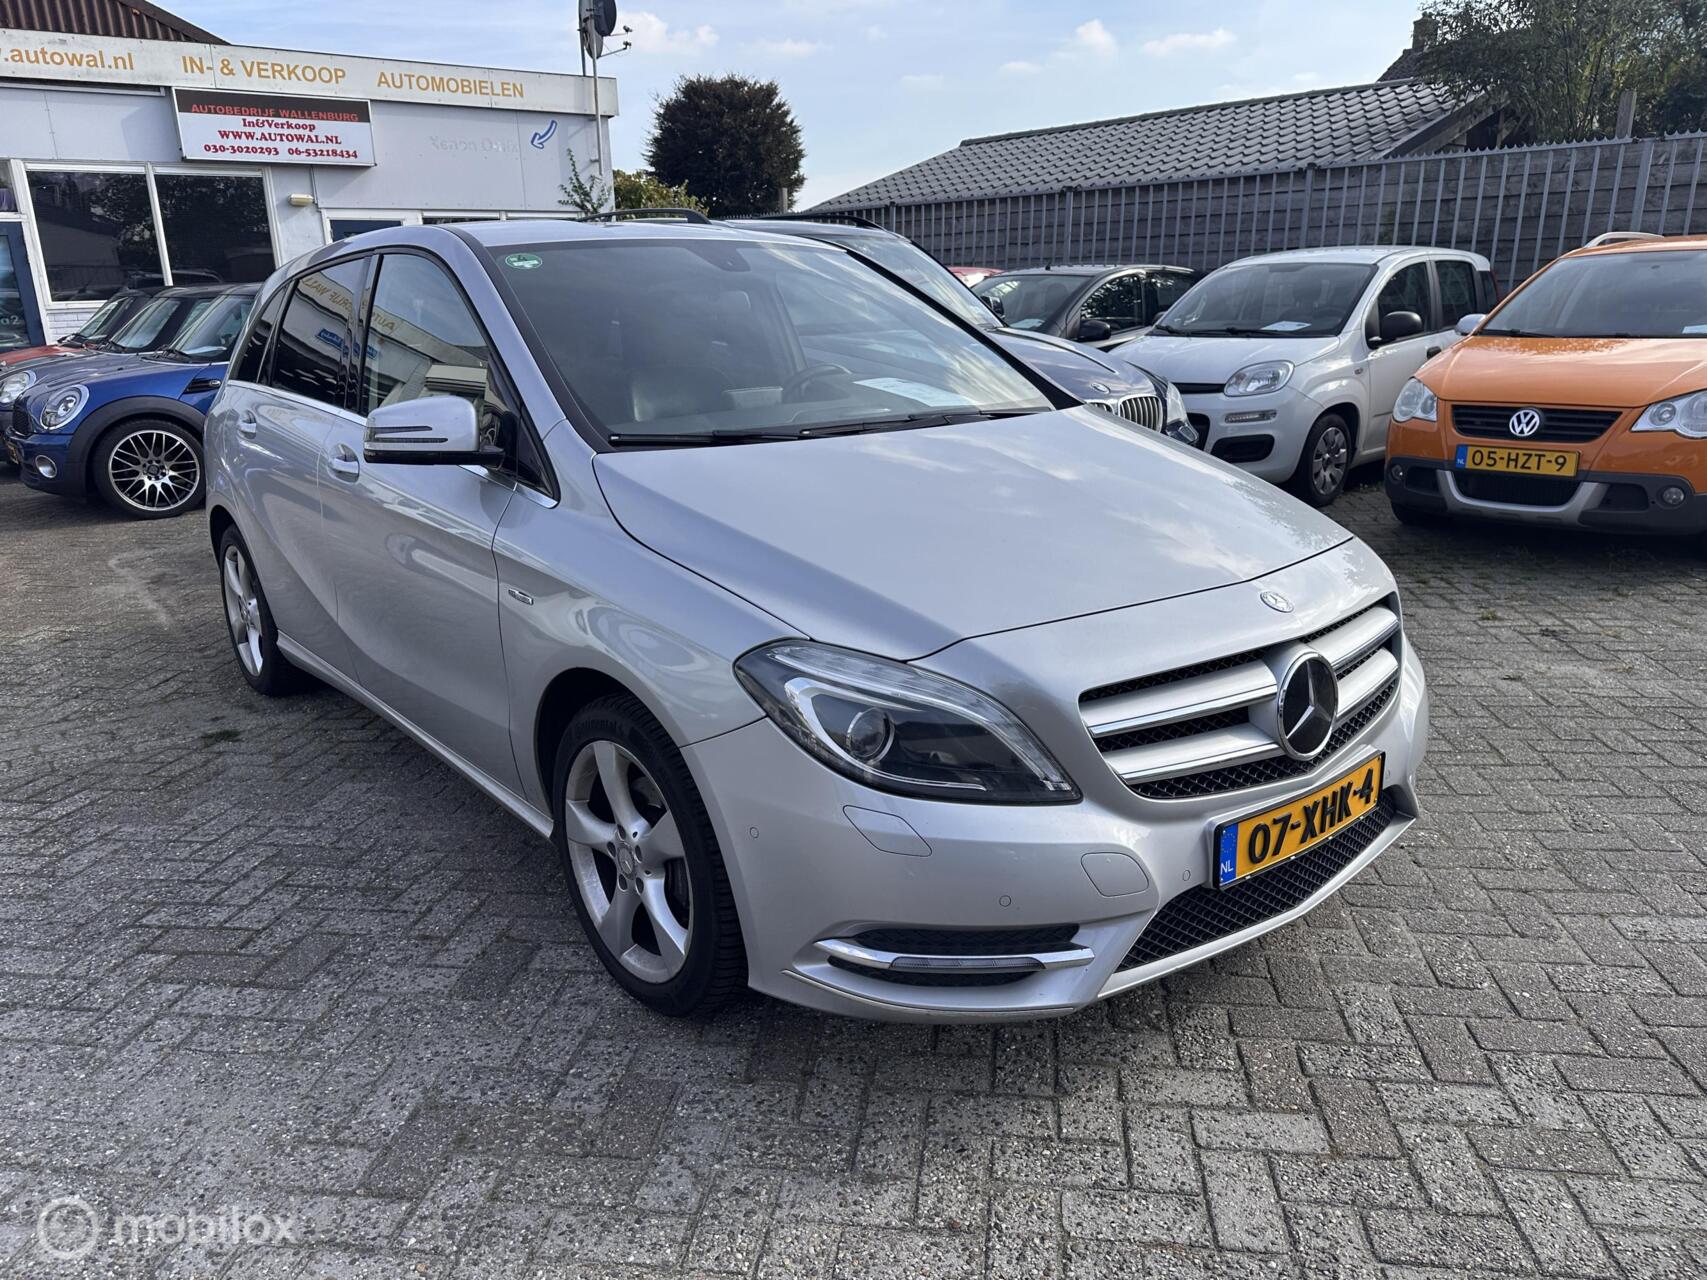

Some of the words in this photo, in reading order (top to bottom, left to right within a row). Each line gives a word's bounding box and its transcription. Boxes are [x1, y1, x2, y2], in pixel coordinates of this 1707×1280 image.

[0, 47, 134, 71] .autowal.nl
[182, 56, 213, 74] IN-
[219, 58, 236, 76] &
[240, 60, 346, 85] VERKOOP
[377, 71, 524, 98] AUTOMOBIELEN
[191, 104, 275, 117] AUTOBEDRIJF
[279, 109, 359, 122] WALLENBURG
[242, 118, 316, 131] In&Verkoop
[218, 130, 342, 145] WWW.AUTOWAL.NL
[204, 144, 280, 156] 030-3020293
[287, 148, 358, 159] 06-53218434
[1472, 450, 1567, 472] 05-HZT-9
[1248, 768, 1374, 864] 07-XHK-4
[1220, 860, 1234, 875] NL
